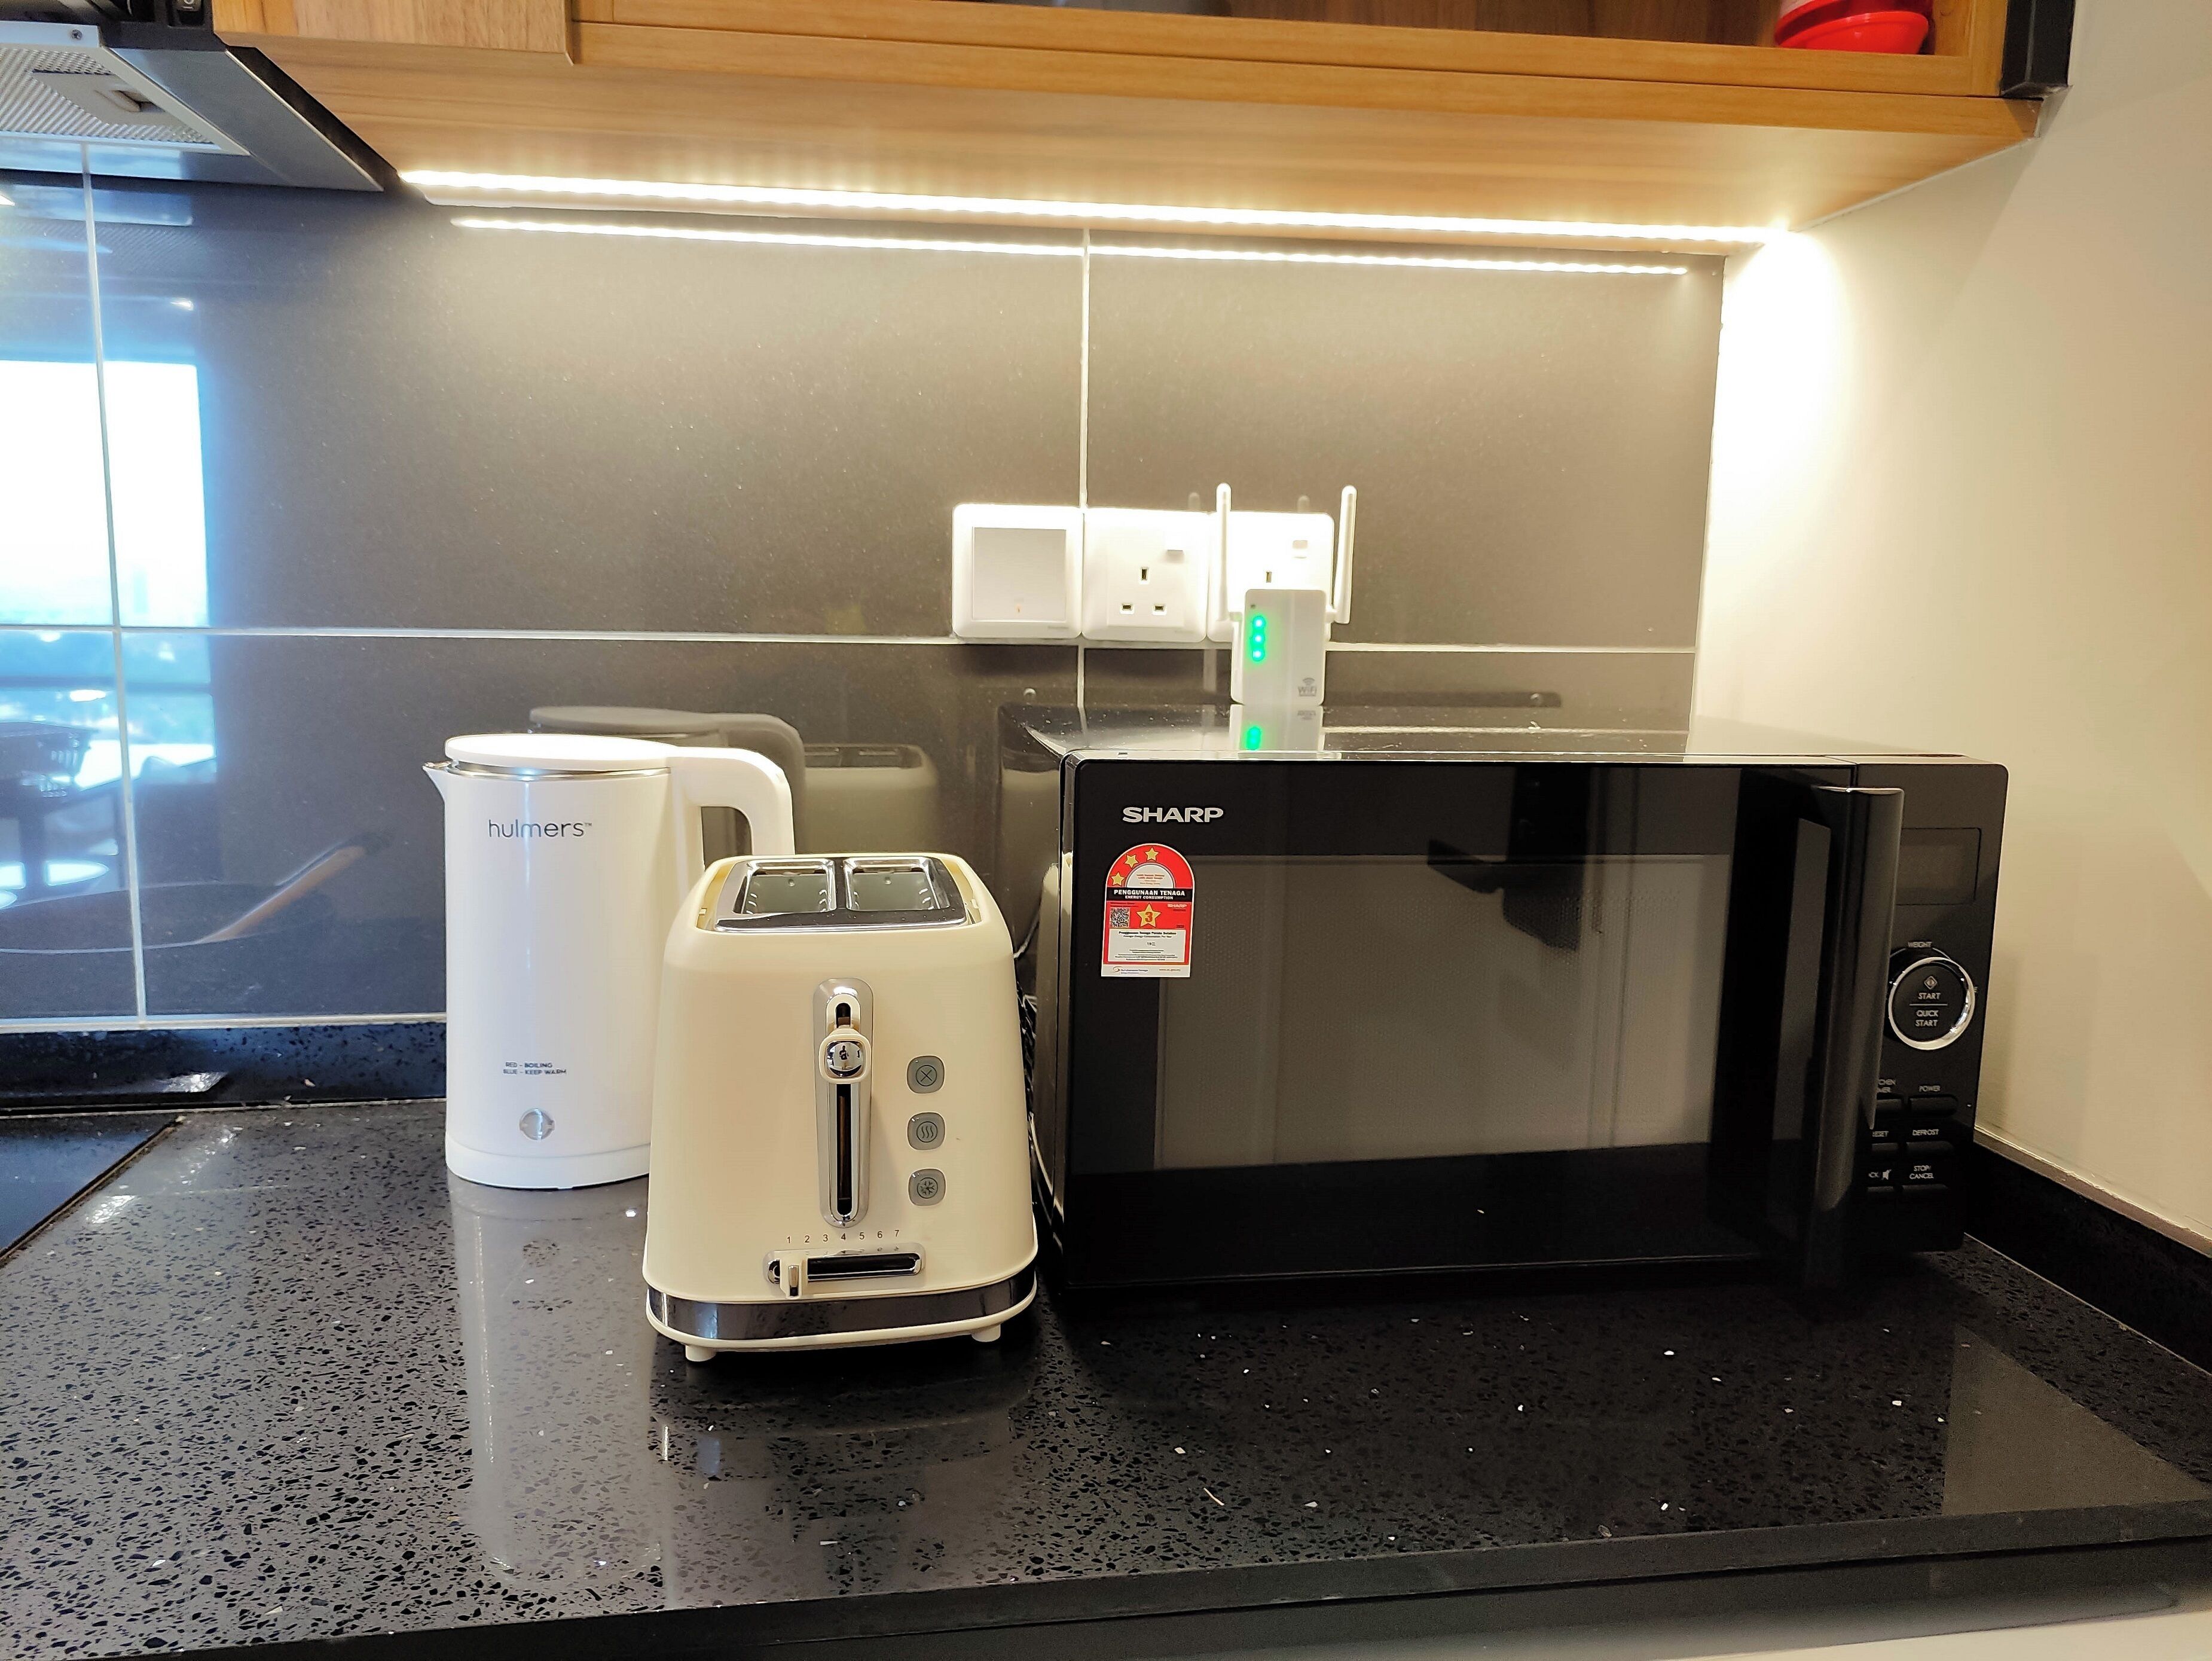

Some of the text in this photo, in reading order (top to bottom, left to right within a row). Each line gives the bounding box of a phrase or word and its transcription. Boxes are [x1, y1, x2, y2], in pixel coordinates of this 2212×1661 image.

[1123, 807, 1224, 823] SHARP
[1145, 911, 1153, 922] 3
[804, 1235, 810, 1243] 2
[859, 1232, 865, 1240] 5
[877, 1231, 883, 1239] 6
